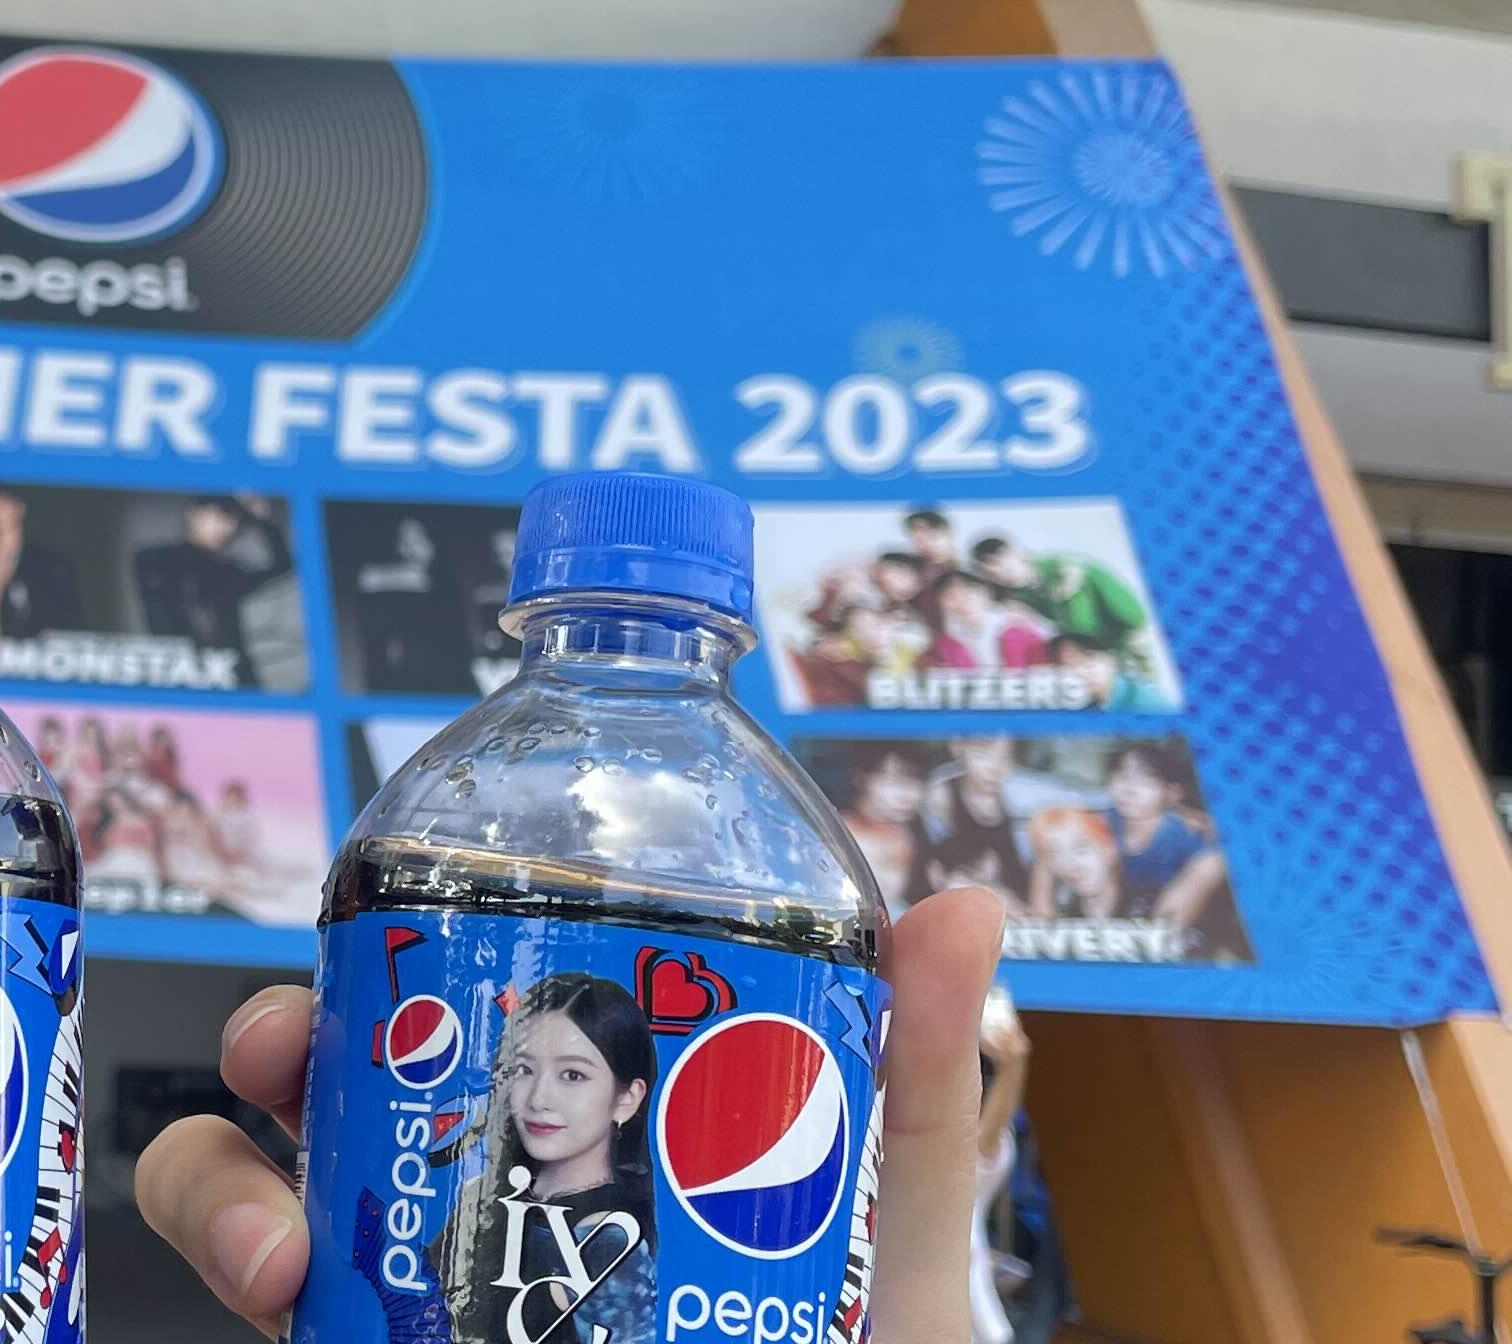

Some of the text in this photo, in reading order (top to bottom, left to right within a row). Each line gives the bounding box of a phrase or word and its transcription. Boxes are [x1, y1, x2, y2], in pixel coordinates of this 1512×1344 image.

[248, 362, 697, 470] FESTA
[733, 371, 1092, 472] 2023
[867, 666, 1089, 710] BLITZERS
[382, 1099, 437, 1292] pepsi
